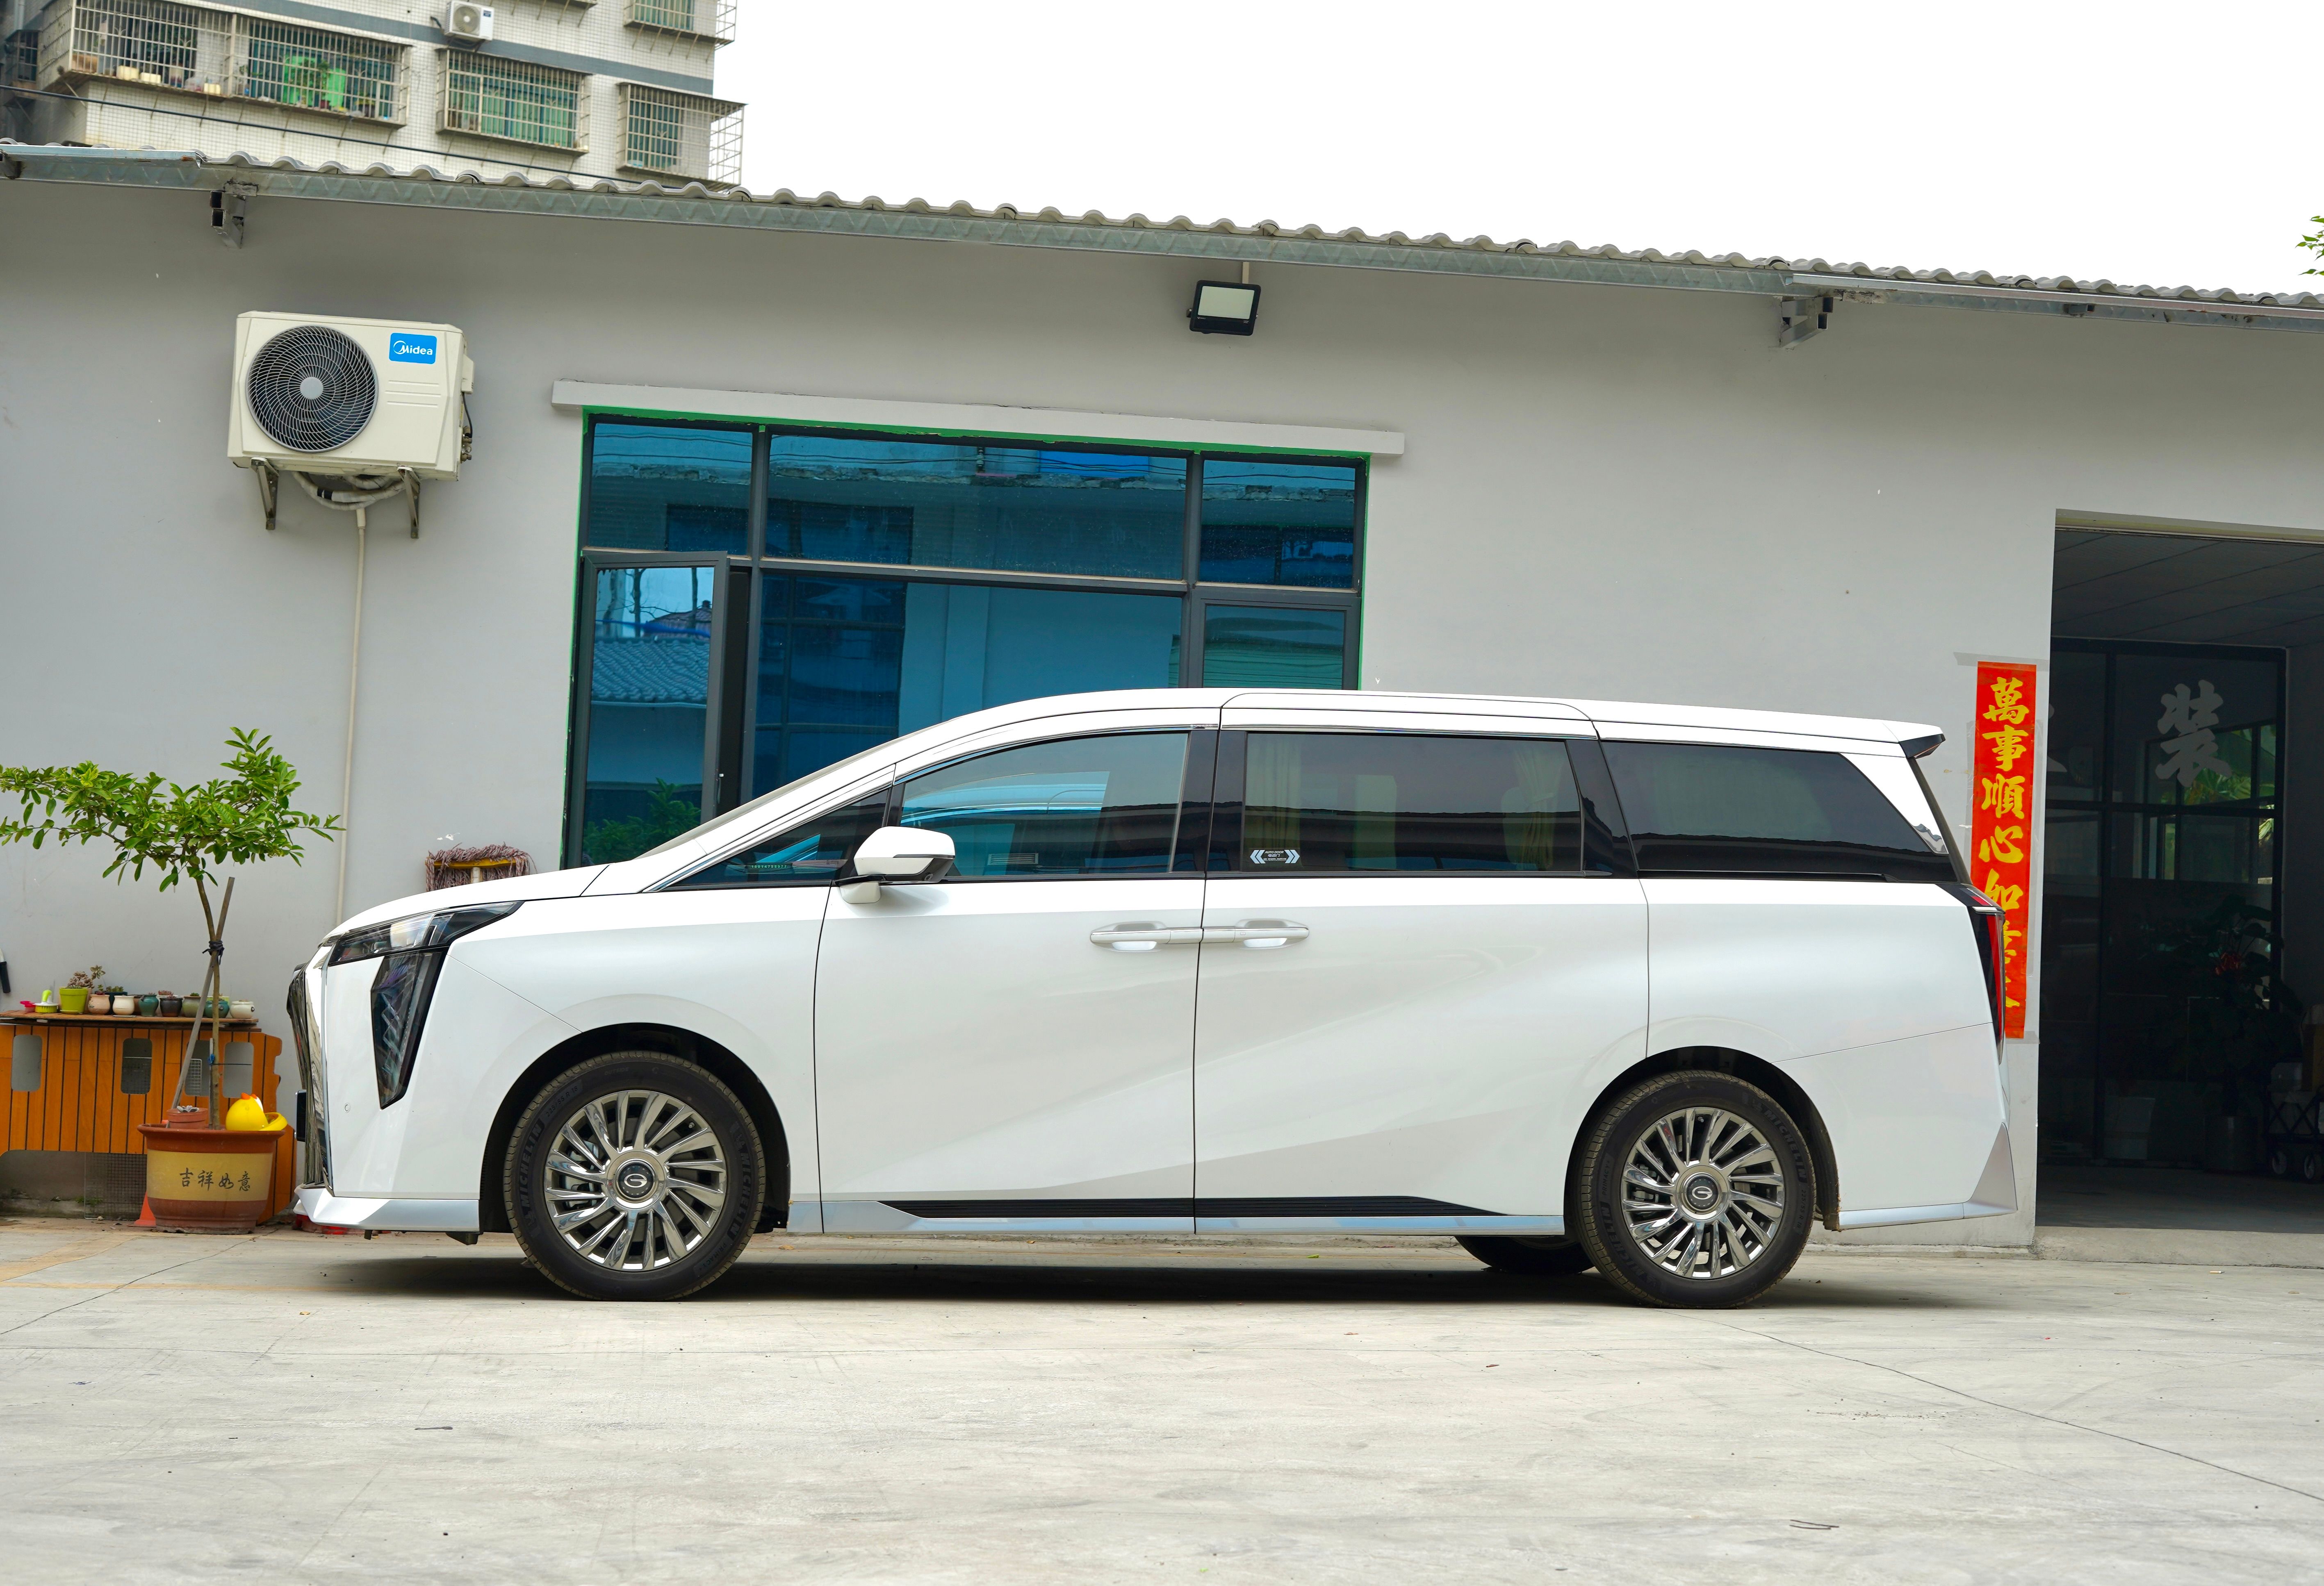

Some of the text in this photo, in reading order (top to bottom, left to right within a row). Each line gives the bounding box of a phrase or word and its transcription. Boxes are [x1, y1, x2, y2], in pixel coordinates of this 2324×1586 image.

[393, 340, 433, 355] Midea
[1979, 677, 2030, 1008] 萬事順心如
[518, 1124, 541, 1208] MICHELIN
[1764, 1109, 1807, 1179] MICHELIN
[180, 1167, 251, 1192] 吉祥如意
[731, 1151, 752, 1234] MICHELIN
[1602, 1163, 1611, 1196] PRIMACY
[702, 1242, 727, 1267] PRIMACY
[1602, 1207, 1648, 1279] MICHELIN
